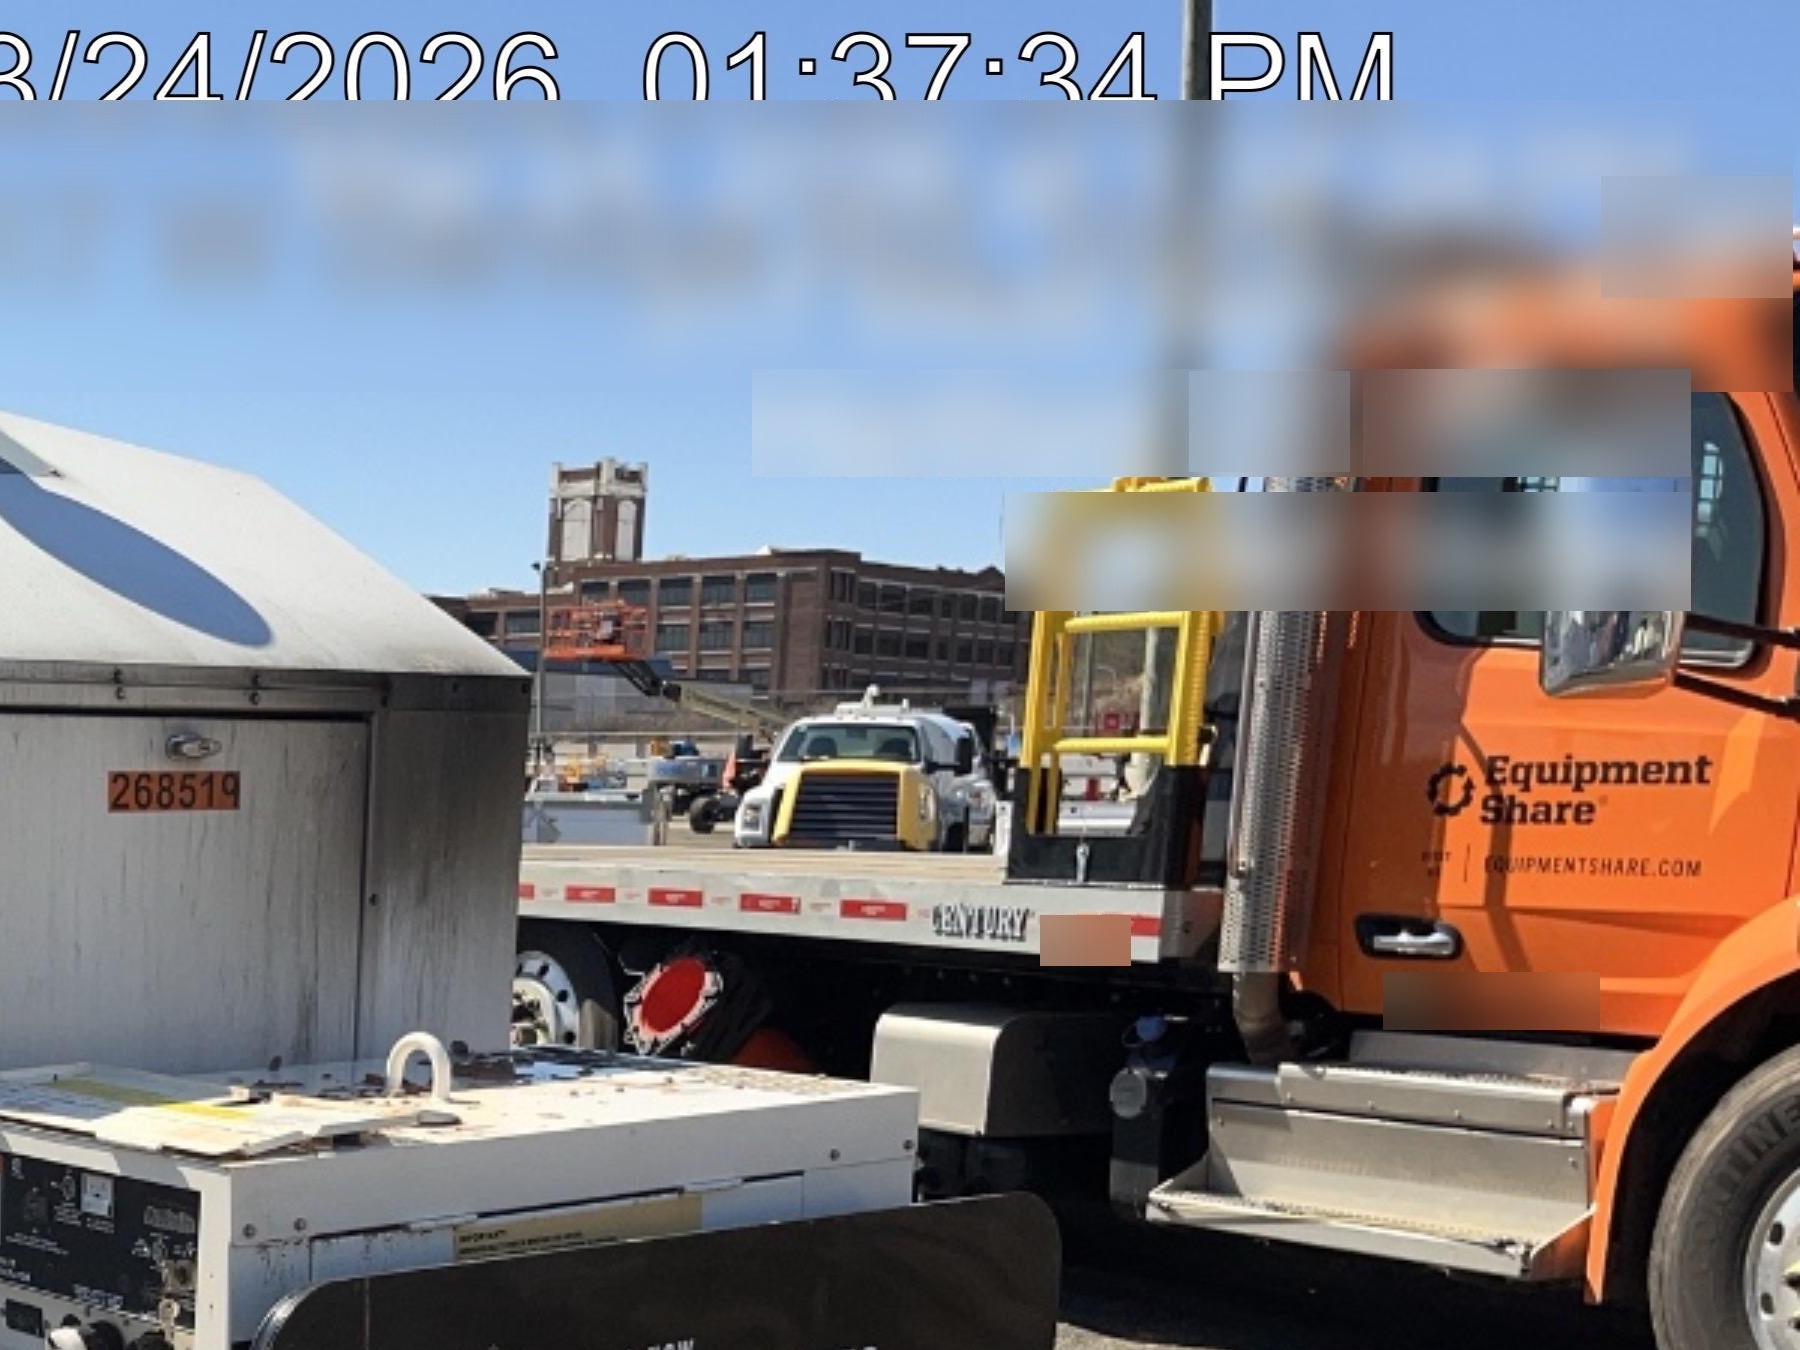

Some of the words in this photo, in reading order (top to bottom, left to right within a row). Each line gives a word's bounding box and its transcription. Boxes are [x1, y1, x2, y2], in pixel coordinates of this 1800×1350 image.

[111, 773, 241, 810] 268519
[1484, 754, 1713, 793] Equipment
[1480, 794, 1598, 826] Share
[1484, 856, 1702, 878] EQUIPMENTSHARE.COM
[932, 903, 1030, 942] CENTURY
